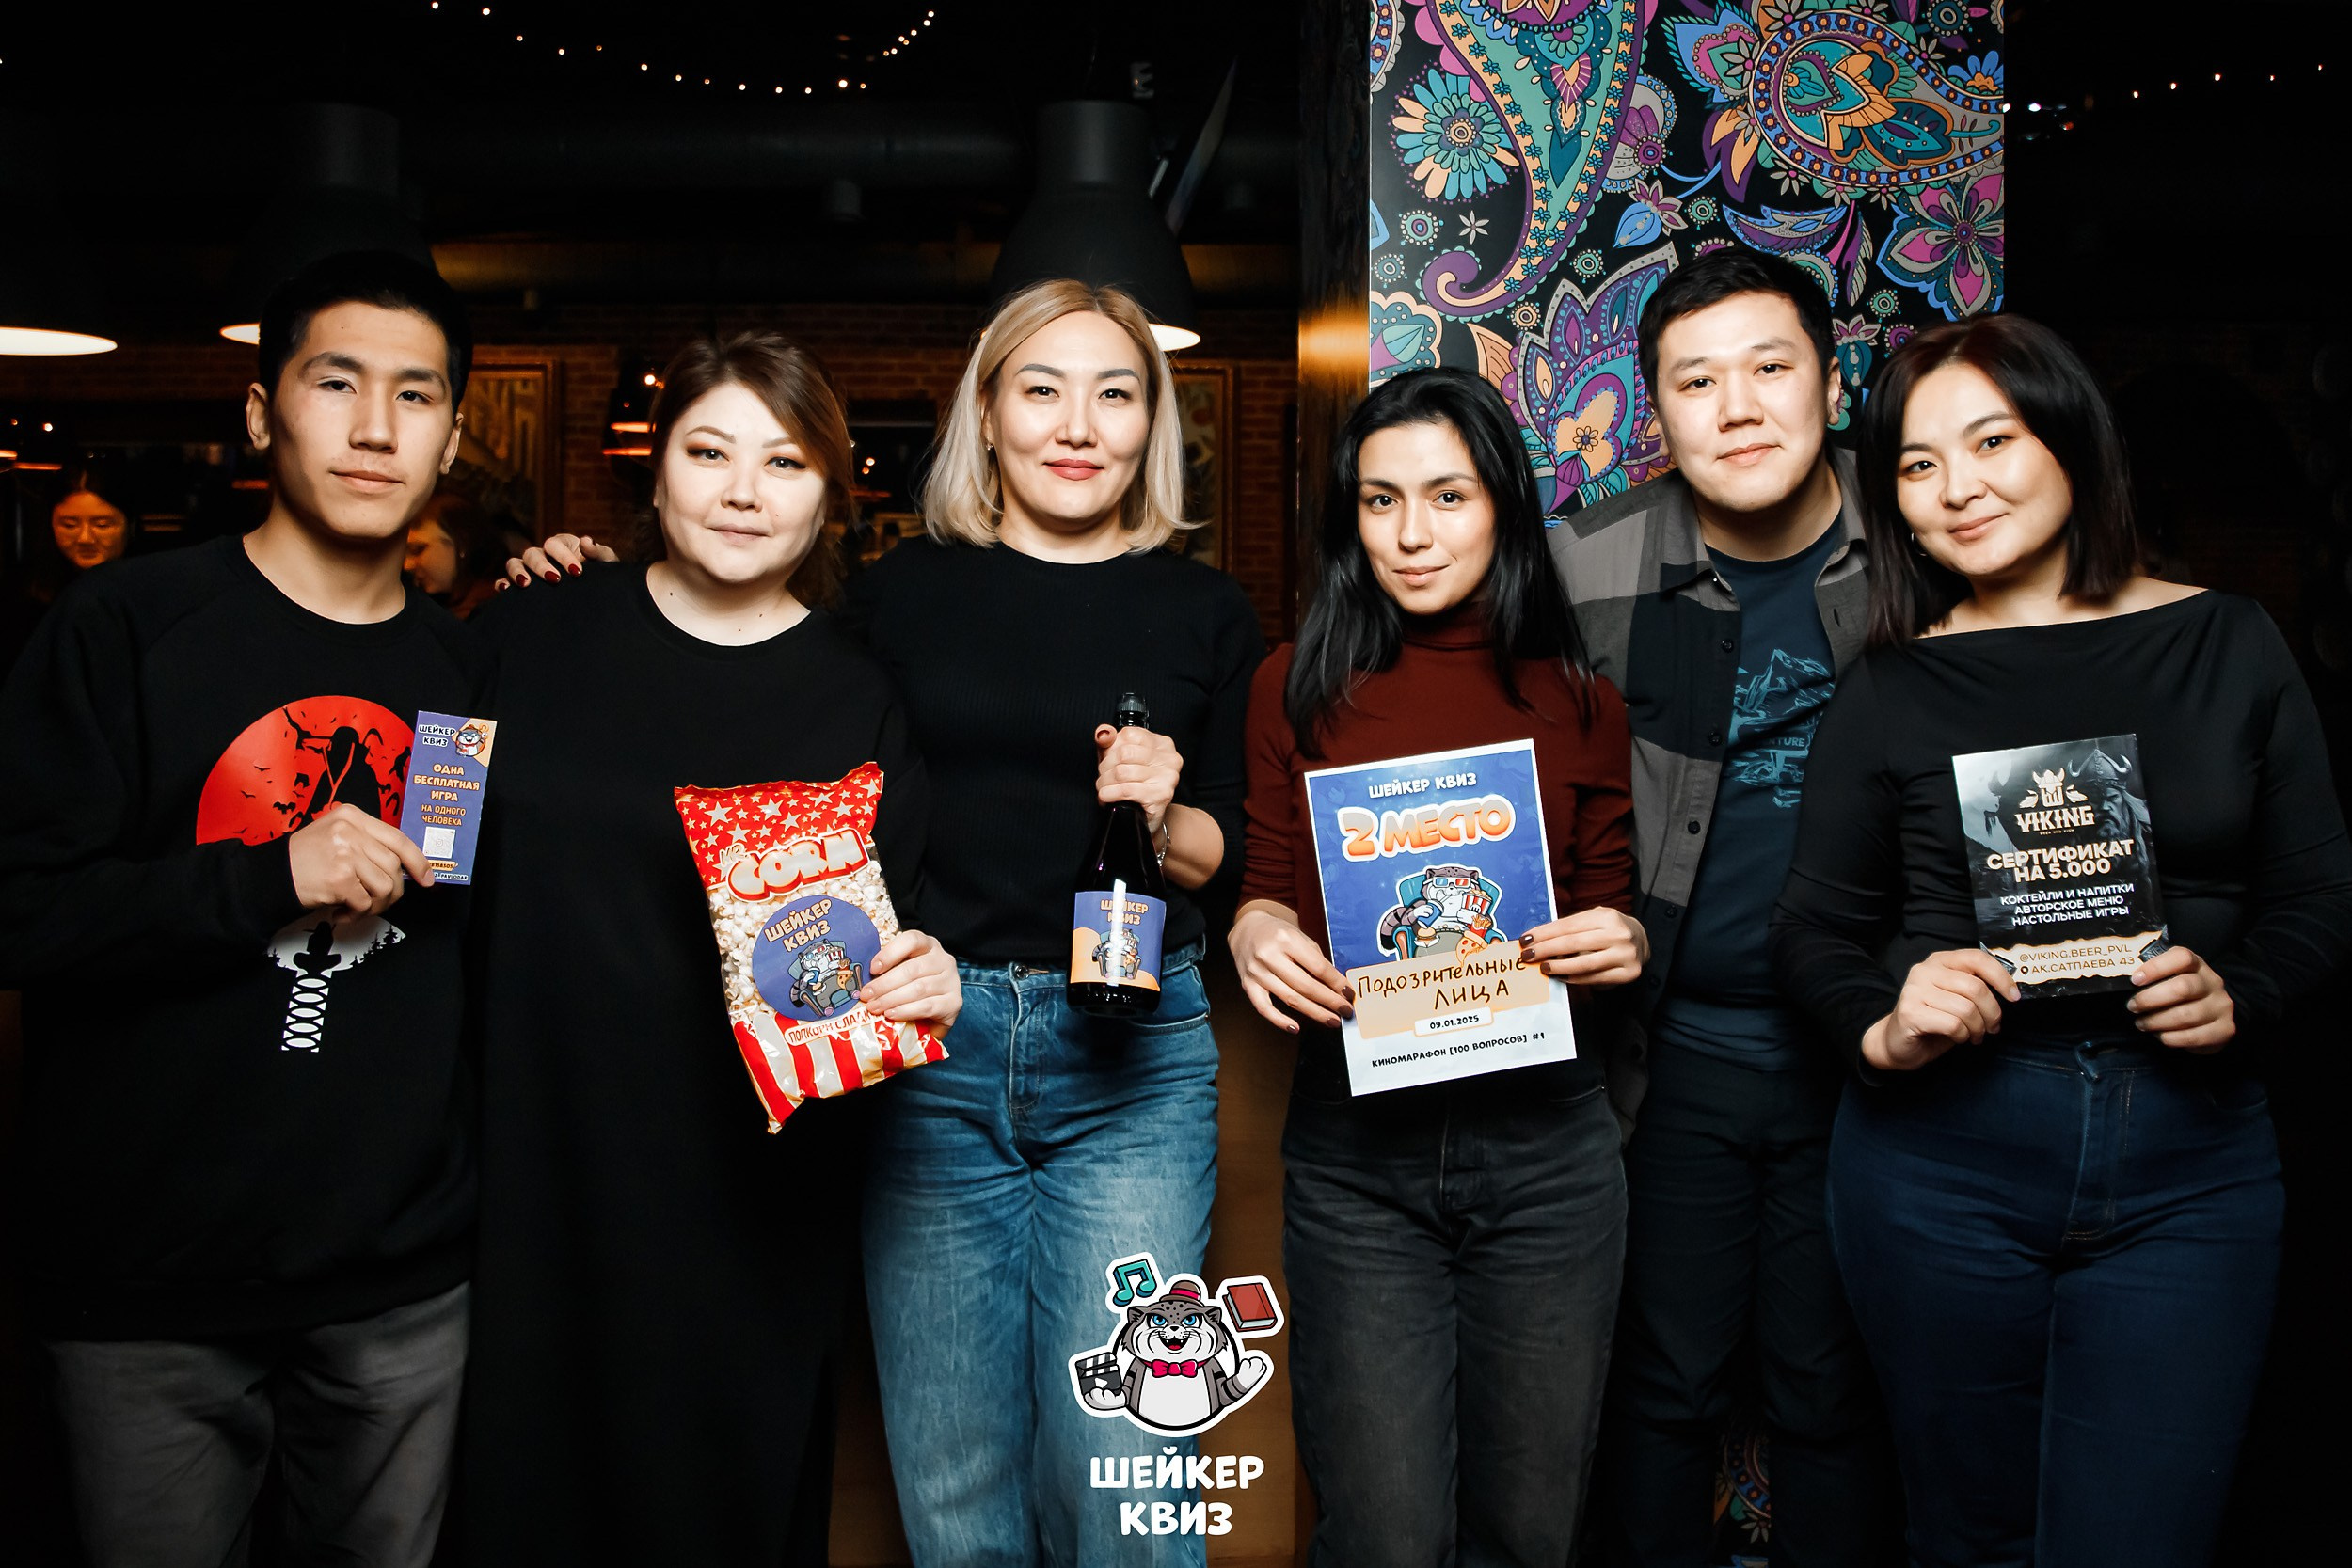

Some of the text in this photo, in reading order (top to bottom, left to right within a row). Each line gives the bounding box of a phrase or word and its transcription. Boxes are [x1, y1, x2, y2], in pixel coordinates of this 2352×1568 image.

[419, 725, 455, 736] ШЕЙКЕР
[423, 736, 448, 747] КВИЗ
[433, 764, 465, 775] ОДНА
[414, 775, 480, 790] БЕСПЛАТНАЯ
[1369, 772, 1477, 799] ШЕЙКЕР КВИЗ
[431, 791, 458, 801] ИГРА
[421, 804, 466, 816] НА ОДНОГО
[2014, 805, 2095, 832] VIKING
[421, 816, 462, 826] ЧЕЛОВЕКА
[1340, 798, 1513, 858] 2 МЕСТО
[728, 829, 867, 900] CORN
[1987, 839, 2134, 870] СЕРТИФИКАТ
[2014, 858, 2111, 882] НА 5.000
[2000, 883, 2134, 906] КОКТЕЙЛИ И НАПИТКИ
[2014, 895, 2124, 915] АВТОРСКОЕ МЕНЮ
[763, 898, 833, 942] ШЕЙКЕР
[2011, 906, 2129, 927] НАСТОЛЬНЫЕ ИГРЫ
[783, 920, 832, 952] КВИЗ
[2019, 944, 2132, 963] @VIKING.BEER_PVL
[2031, 957, 2135, 974] АК.САТПАЕВА 43
[1434, 979, 1510, 1011] ЛИЦА
[788, 1022, 834, 1043] ПОПКОРН
[1429, 1014, 1480, 1030] 09.01.2025
[1372, 1031, 1546, 1068] КИНОМАРАФОН [100 ВОПРОСОВ] #1
